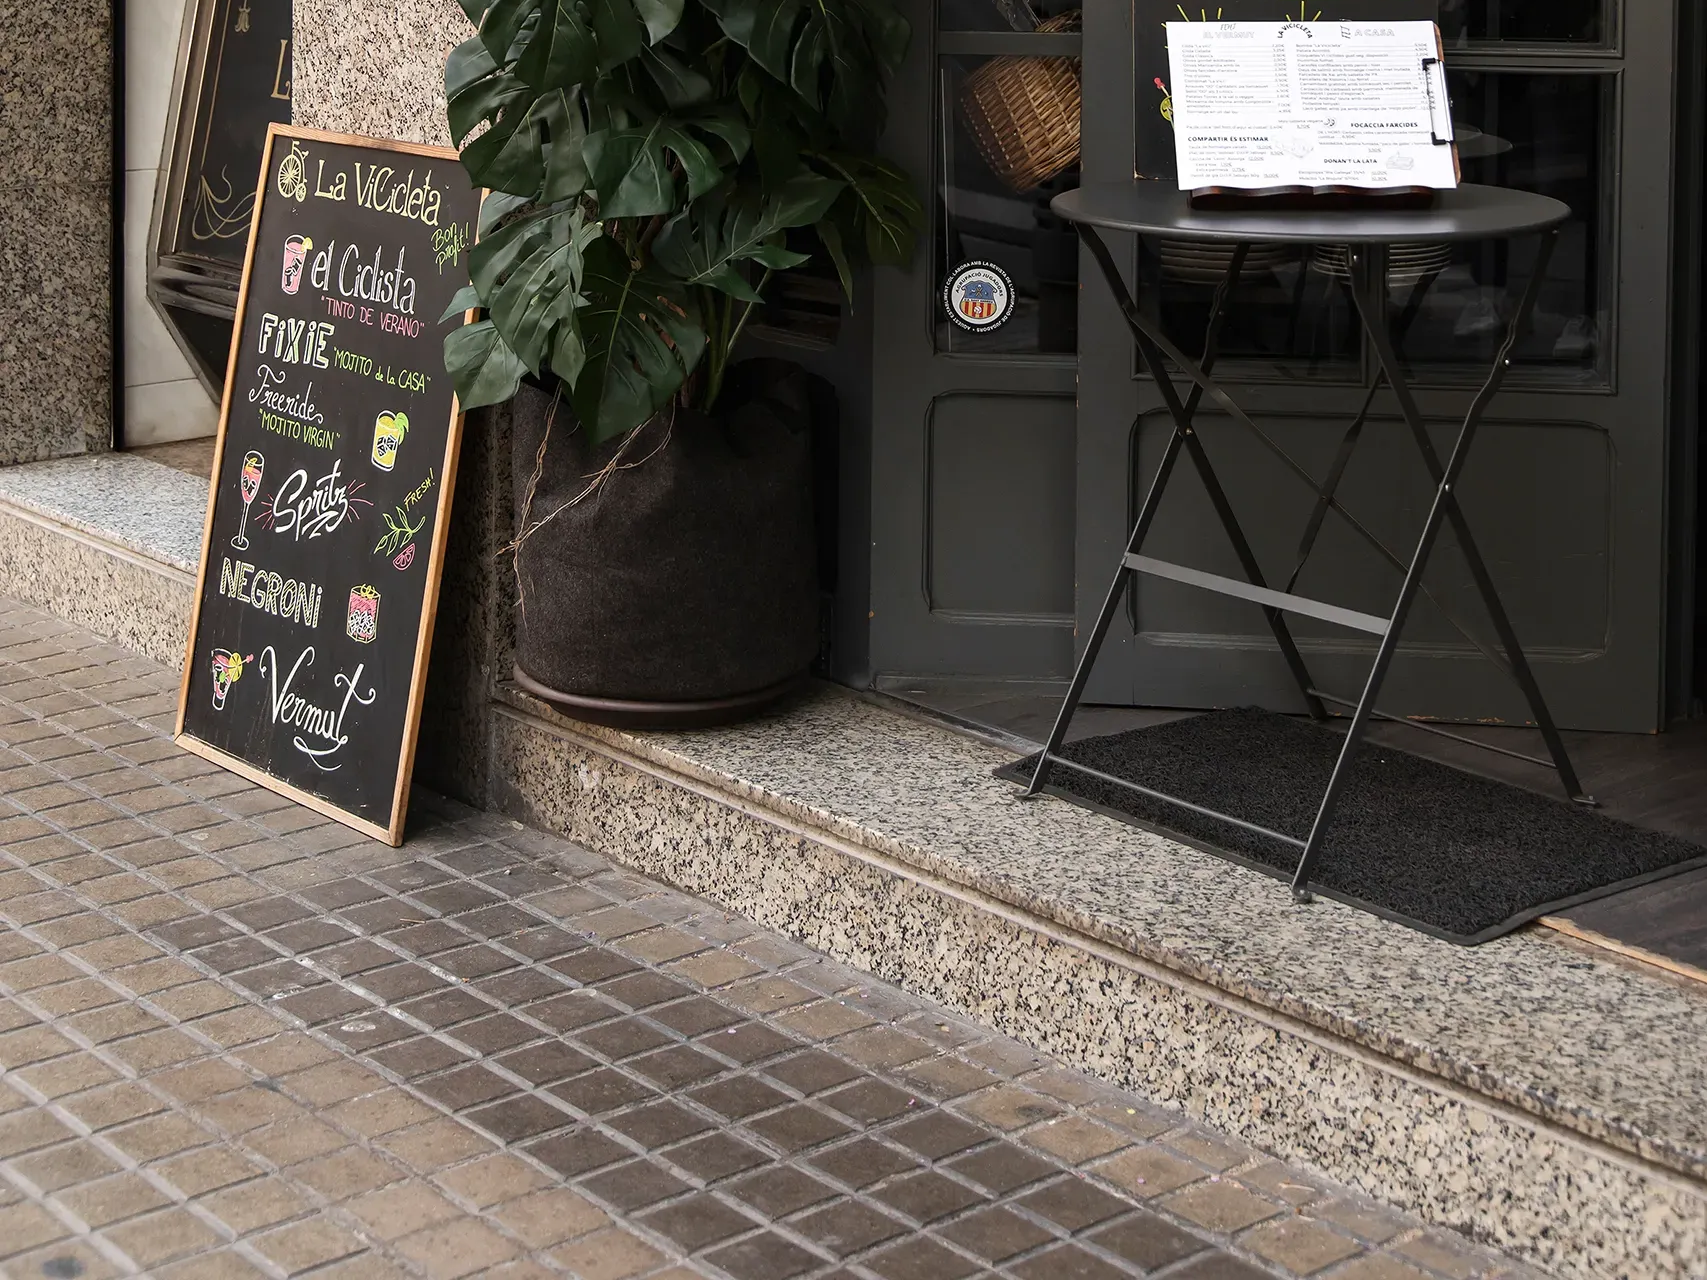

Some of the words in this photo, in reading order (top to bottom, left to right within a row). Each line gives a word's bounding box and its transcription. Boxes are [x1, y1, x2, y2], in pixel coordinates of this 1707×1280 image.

[1281, 23, 1313, 39] VICICLETA
[1364, 28, 1395, 37] CASA
[314, 159, 347, 201] La
[431, 222, 457, 252] Bon
[311, 240, 336, 291] el
[338, 243, 416, 315] Ciclista
[955, 271, 982, 293] AGRUPACIÓ
[989, 263, 1007, 279] REVISTA
[359, 305, 375, 327] DE
[943, 285, 955, 318] ESTABLIMENT
[953, 316, 971, 331] AQUEST
[375, 365, 384, 382] de
[386, 365, 396, 385] la
[249, 364, 324, 425] Freeride
[272, 458, 349, 542] Spritz
[404, 467, 435, 511] FRESH!
[259, 645, 376, 746] Vermut
